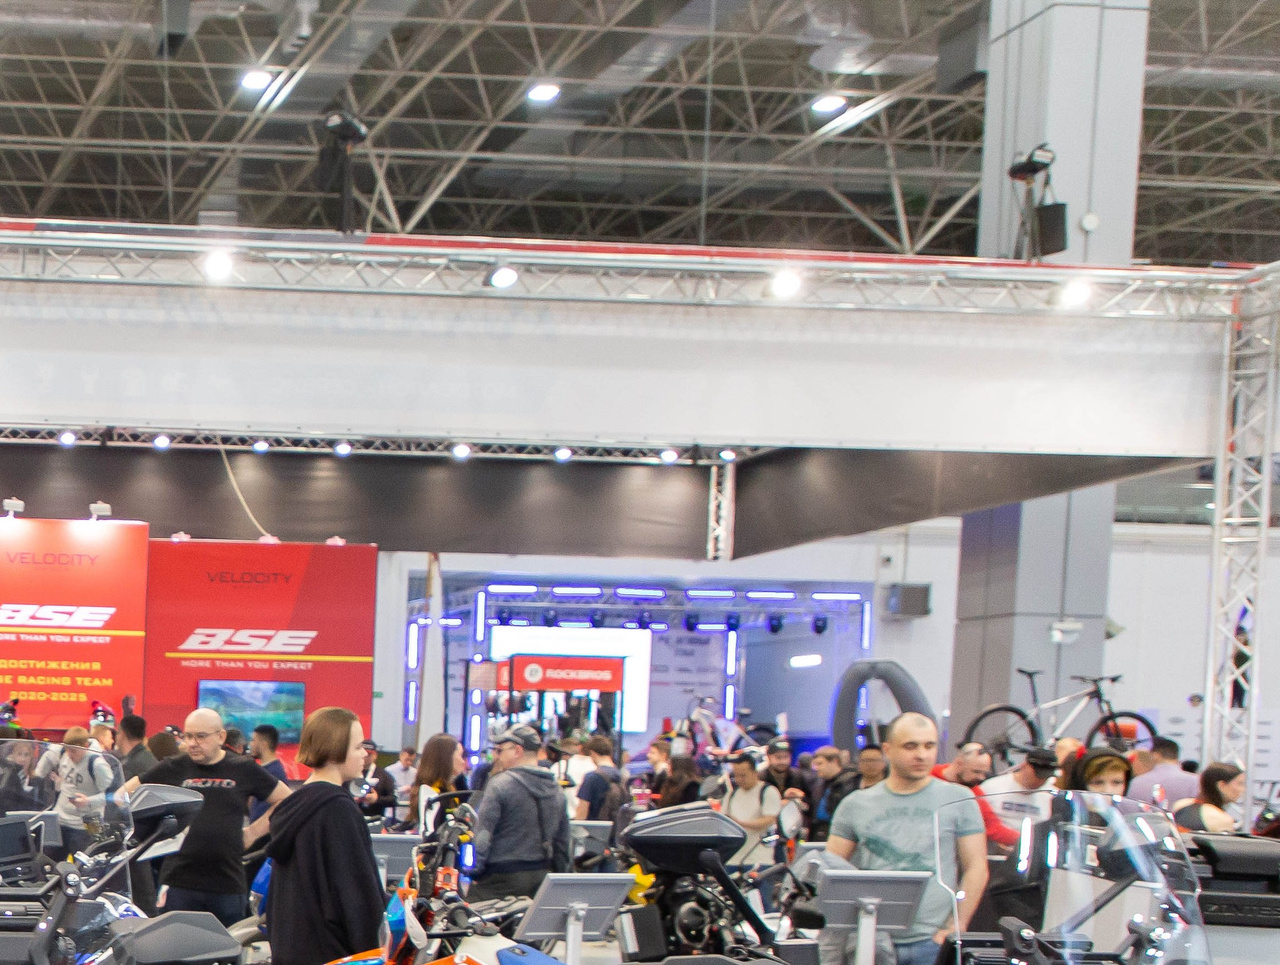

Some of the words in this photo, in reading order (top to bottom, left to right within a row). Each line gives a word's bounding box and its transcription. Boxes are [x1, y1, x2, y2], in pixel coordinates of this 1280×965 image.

[6, 552, 99, 566] VELOCITY
[206, 572, 292, 584] VELOCITY
[21, 634, 47, 642] THAN
[177, 628, 319, 653] BSE
[181, 660, 211, 668] MORE
[273, 662, 313, 670] EXPECT
[18, 675, 71, 685] RACING
[75, 676, 113, 686] TEAM
